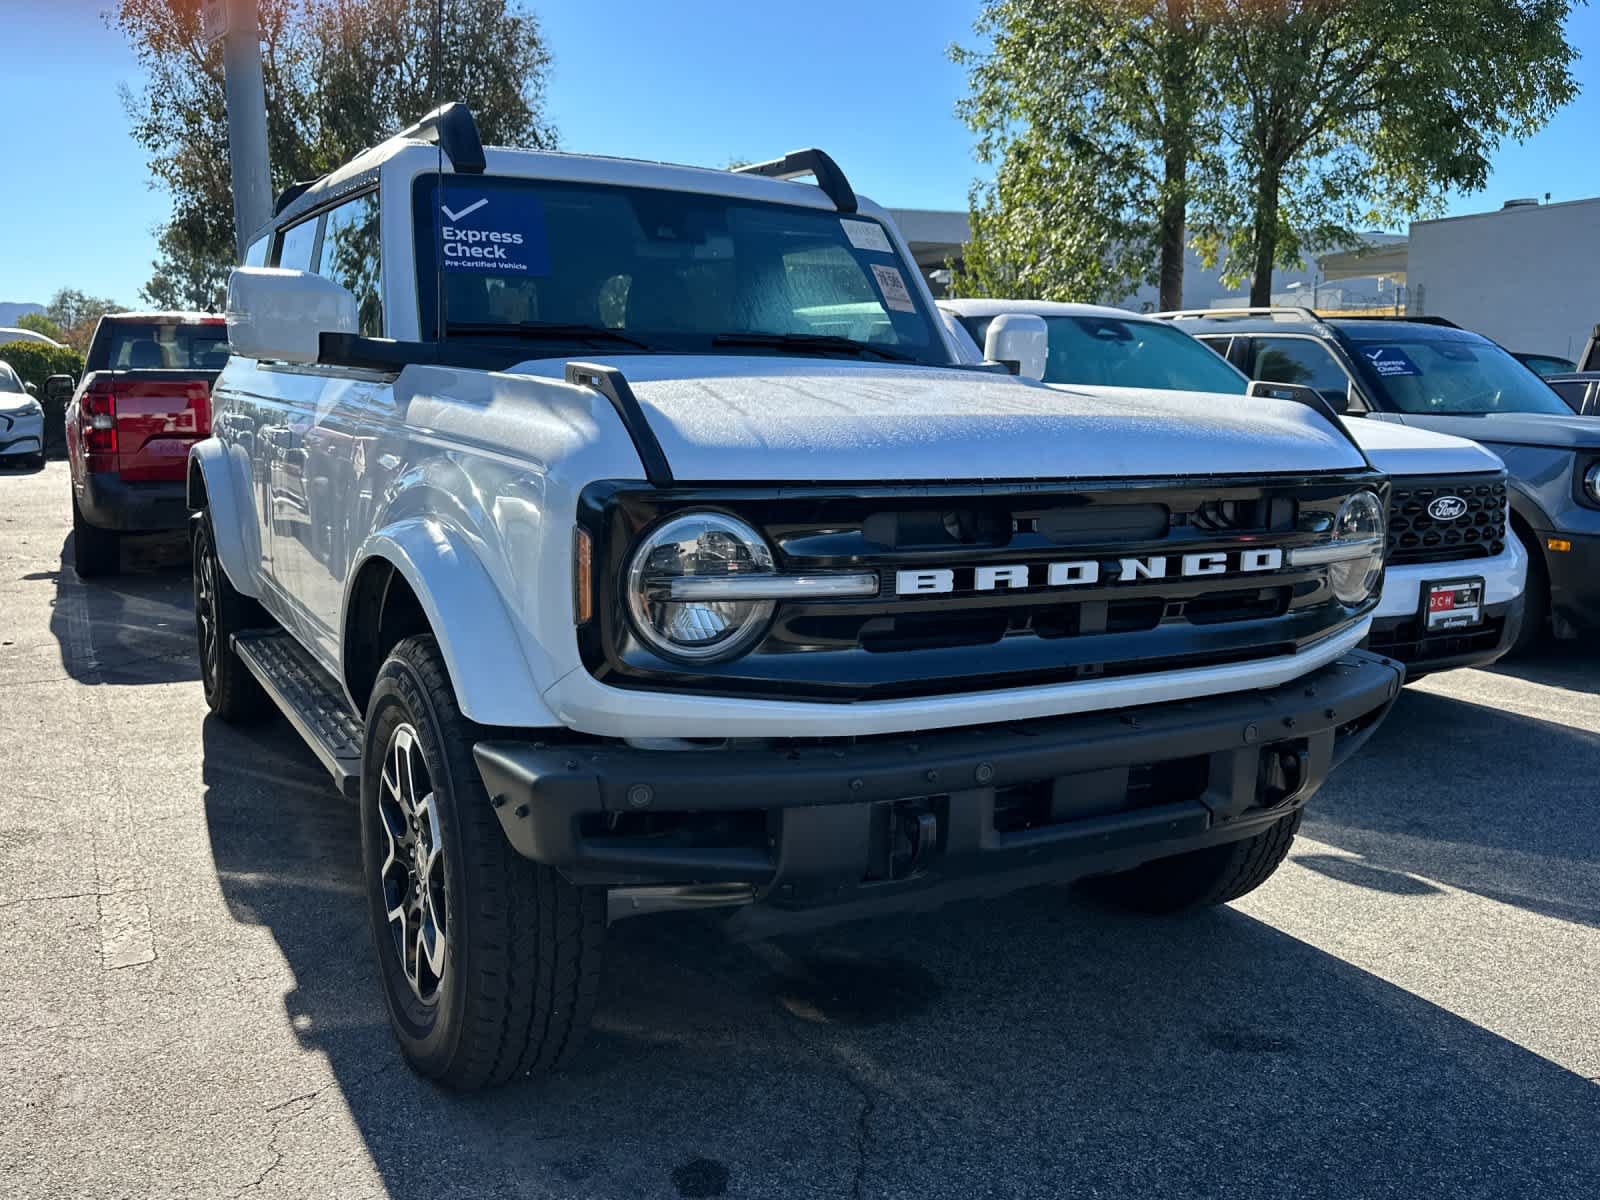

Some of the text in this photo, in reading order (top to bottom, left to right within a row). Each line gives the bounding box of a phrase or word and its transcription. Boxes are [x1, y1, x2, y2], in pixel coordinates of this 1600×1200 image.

[442, 226, 524, 244] Express
[443, 242, 507, 259] Check
[445, 260, 528, 270] Pre-Certified Vehicle
[1434, 499, 1462, 517] Ford
[896, 548, 1282, 595] BRONCO
